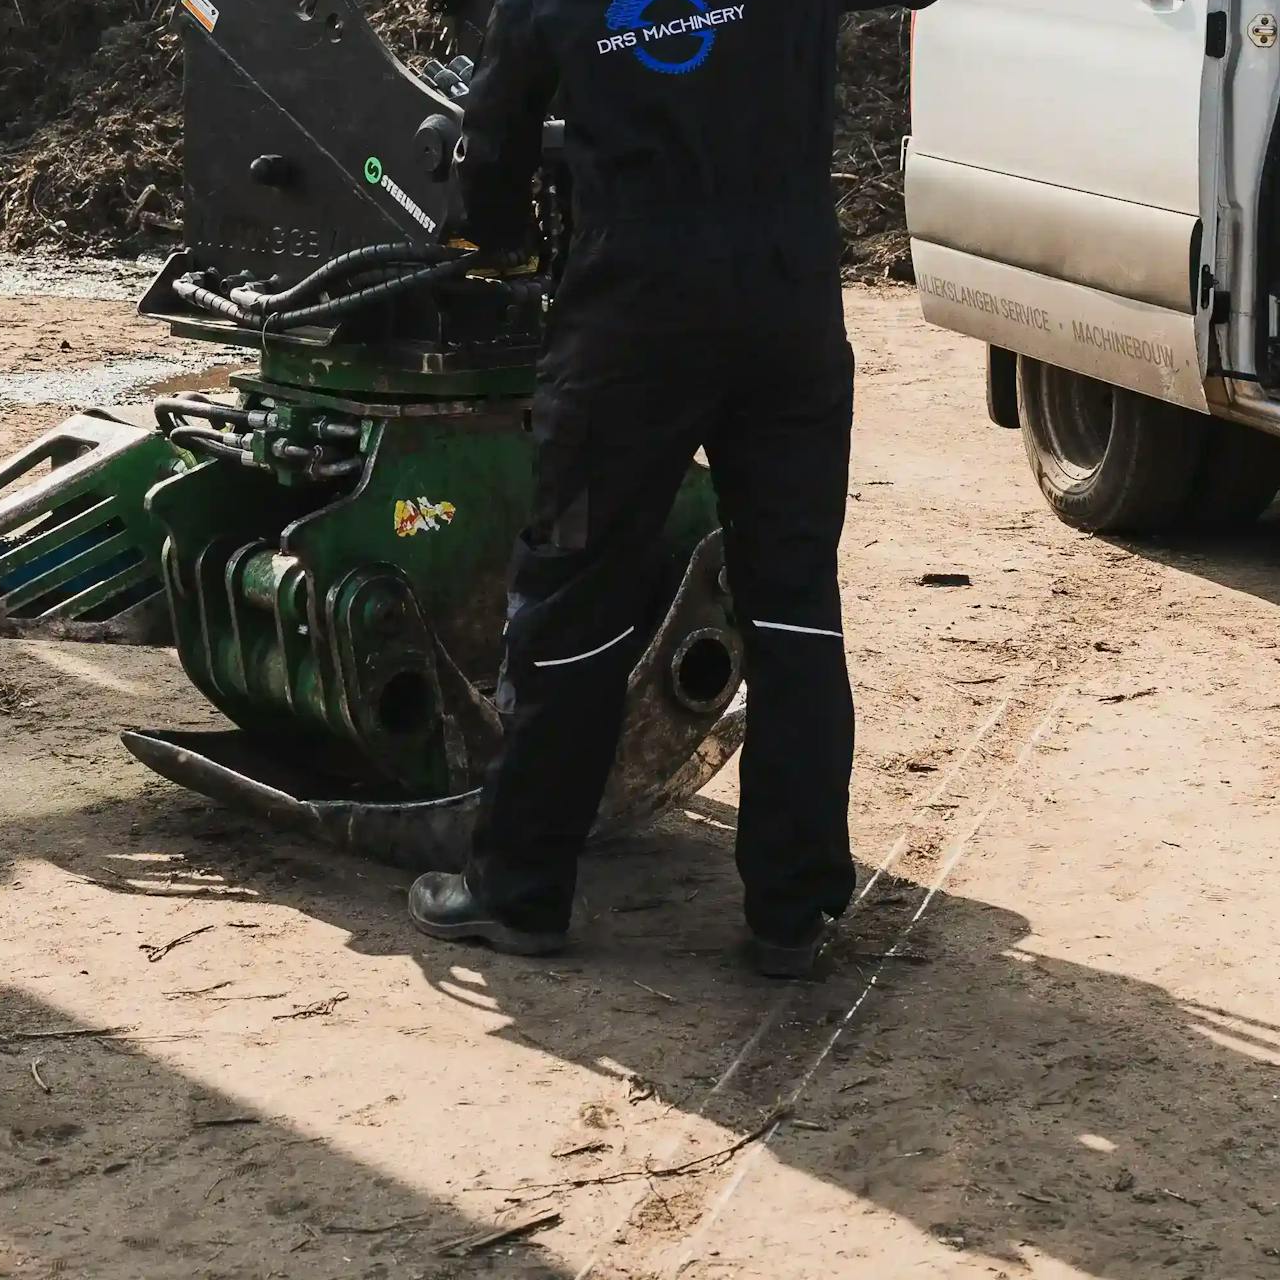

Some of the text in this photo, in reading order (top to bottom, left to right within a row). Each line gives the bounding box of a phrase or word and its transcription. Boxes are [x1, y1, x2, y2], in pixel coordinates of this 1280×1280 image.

[597, 5, 745, 54] DRS MACHINERY
[381, 175, 436, 233] STEELWRIST
[917, 273, 1174, 369] ULIEKSLANGEN SERVICE MACHINEBOUW
